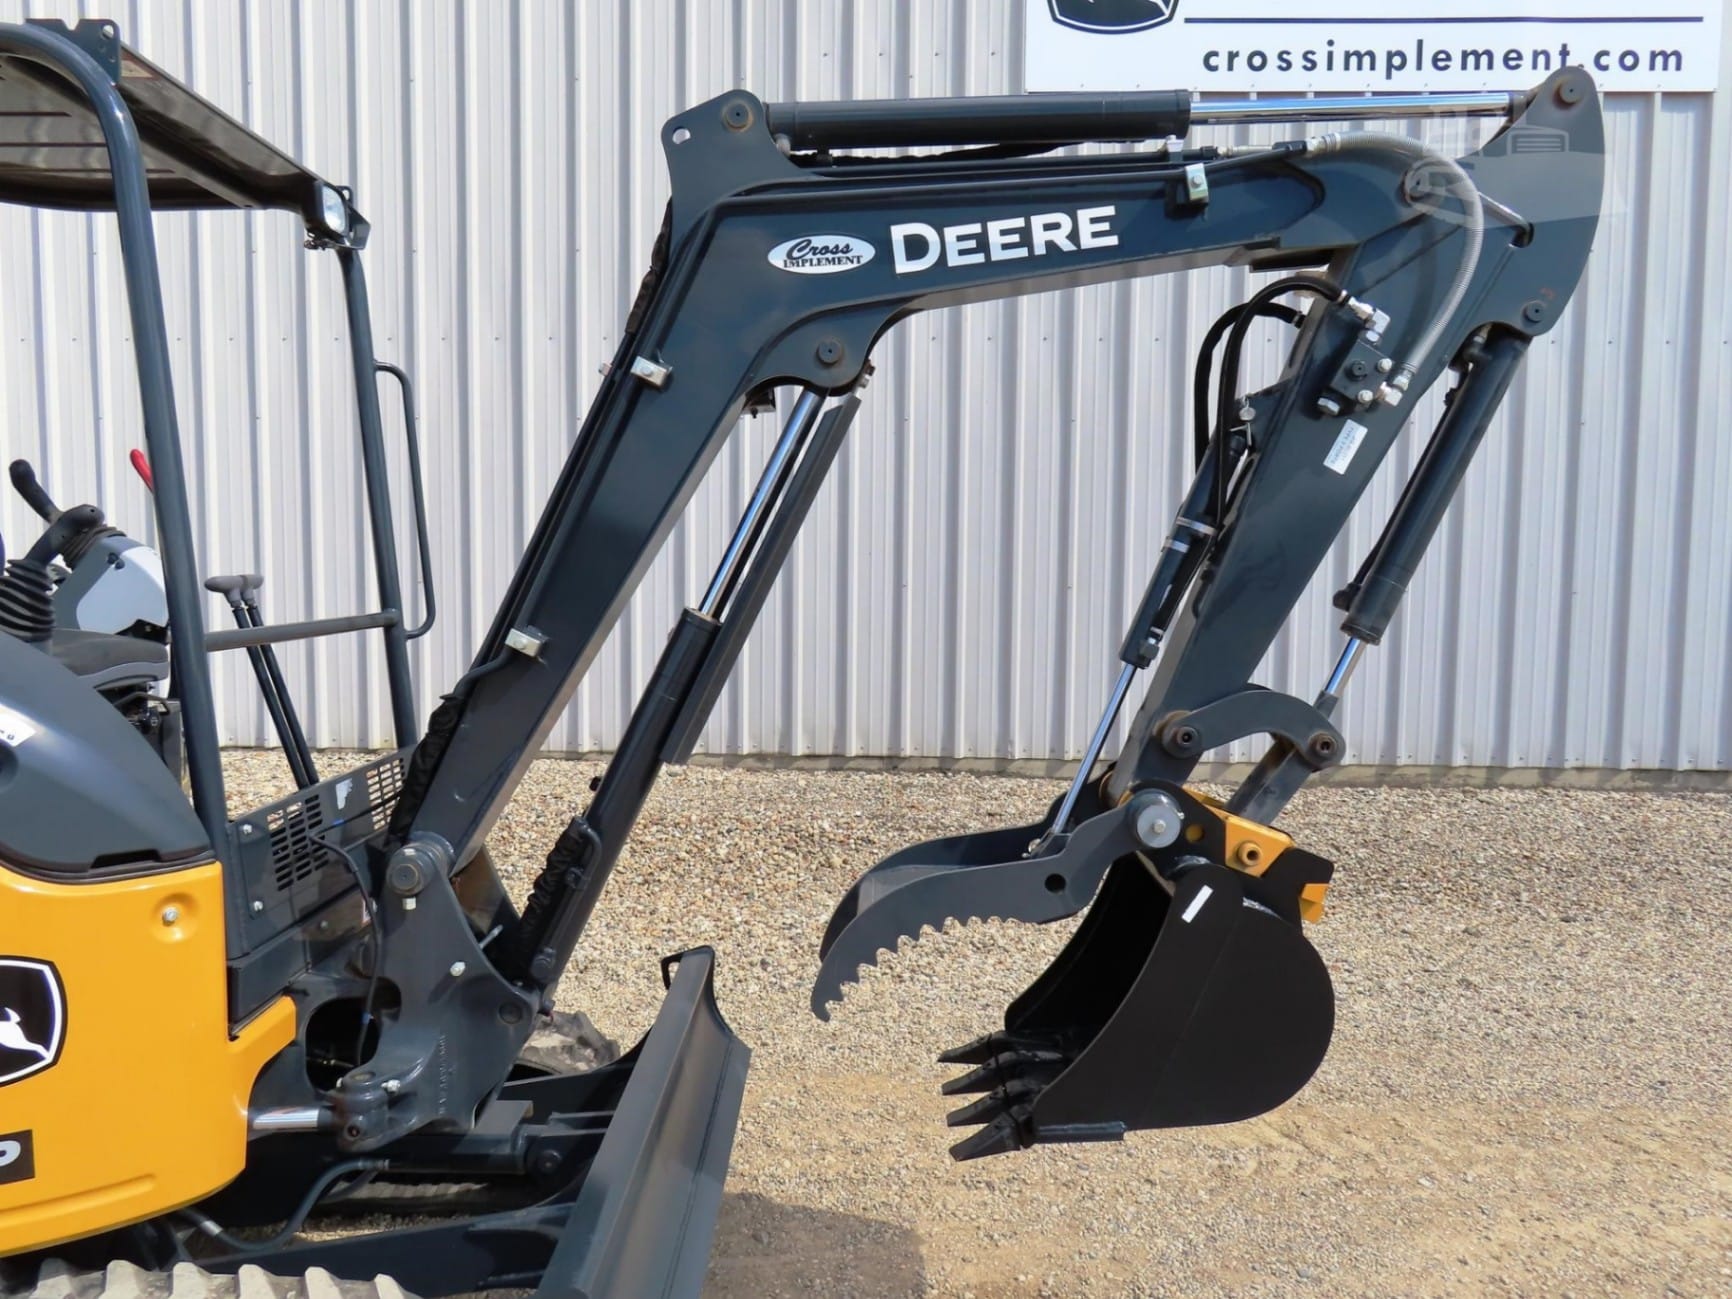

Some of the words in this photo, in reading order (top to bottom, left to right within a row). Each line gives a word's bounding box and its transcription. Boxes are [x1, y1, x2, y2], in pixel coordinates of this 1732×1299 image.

[1202, 39, 1683, 80] crossimplement.com
[786, 238, 853, 260] Cross
[890, 205, 1119, 274] DEERE
[783, 255, 864, 268] IMPLEMENT
